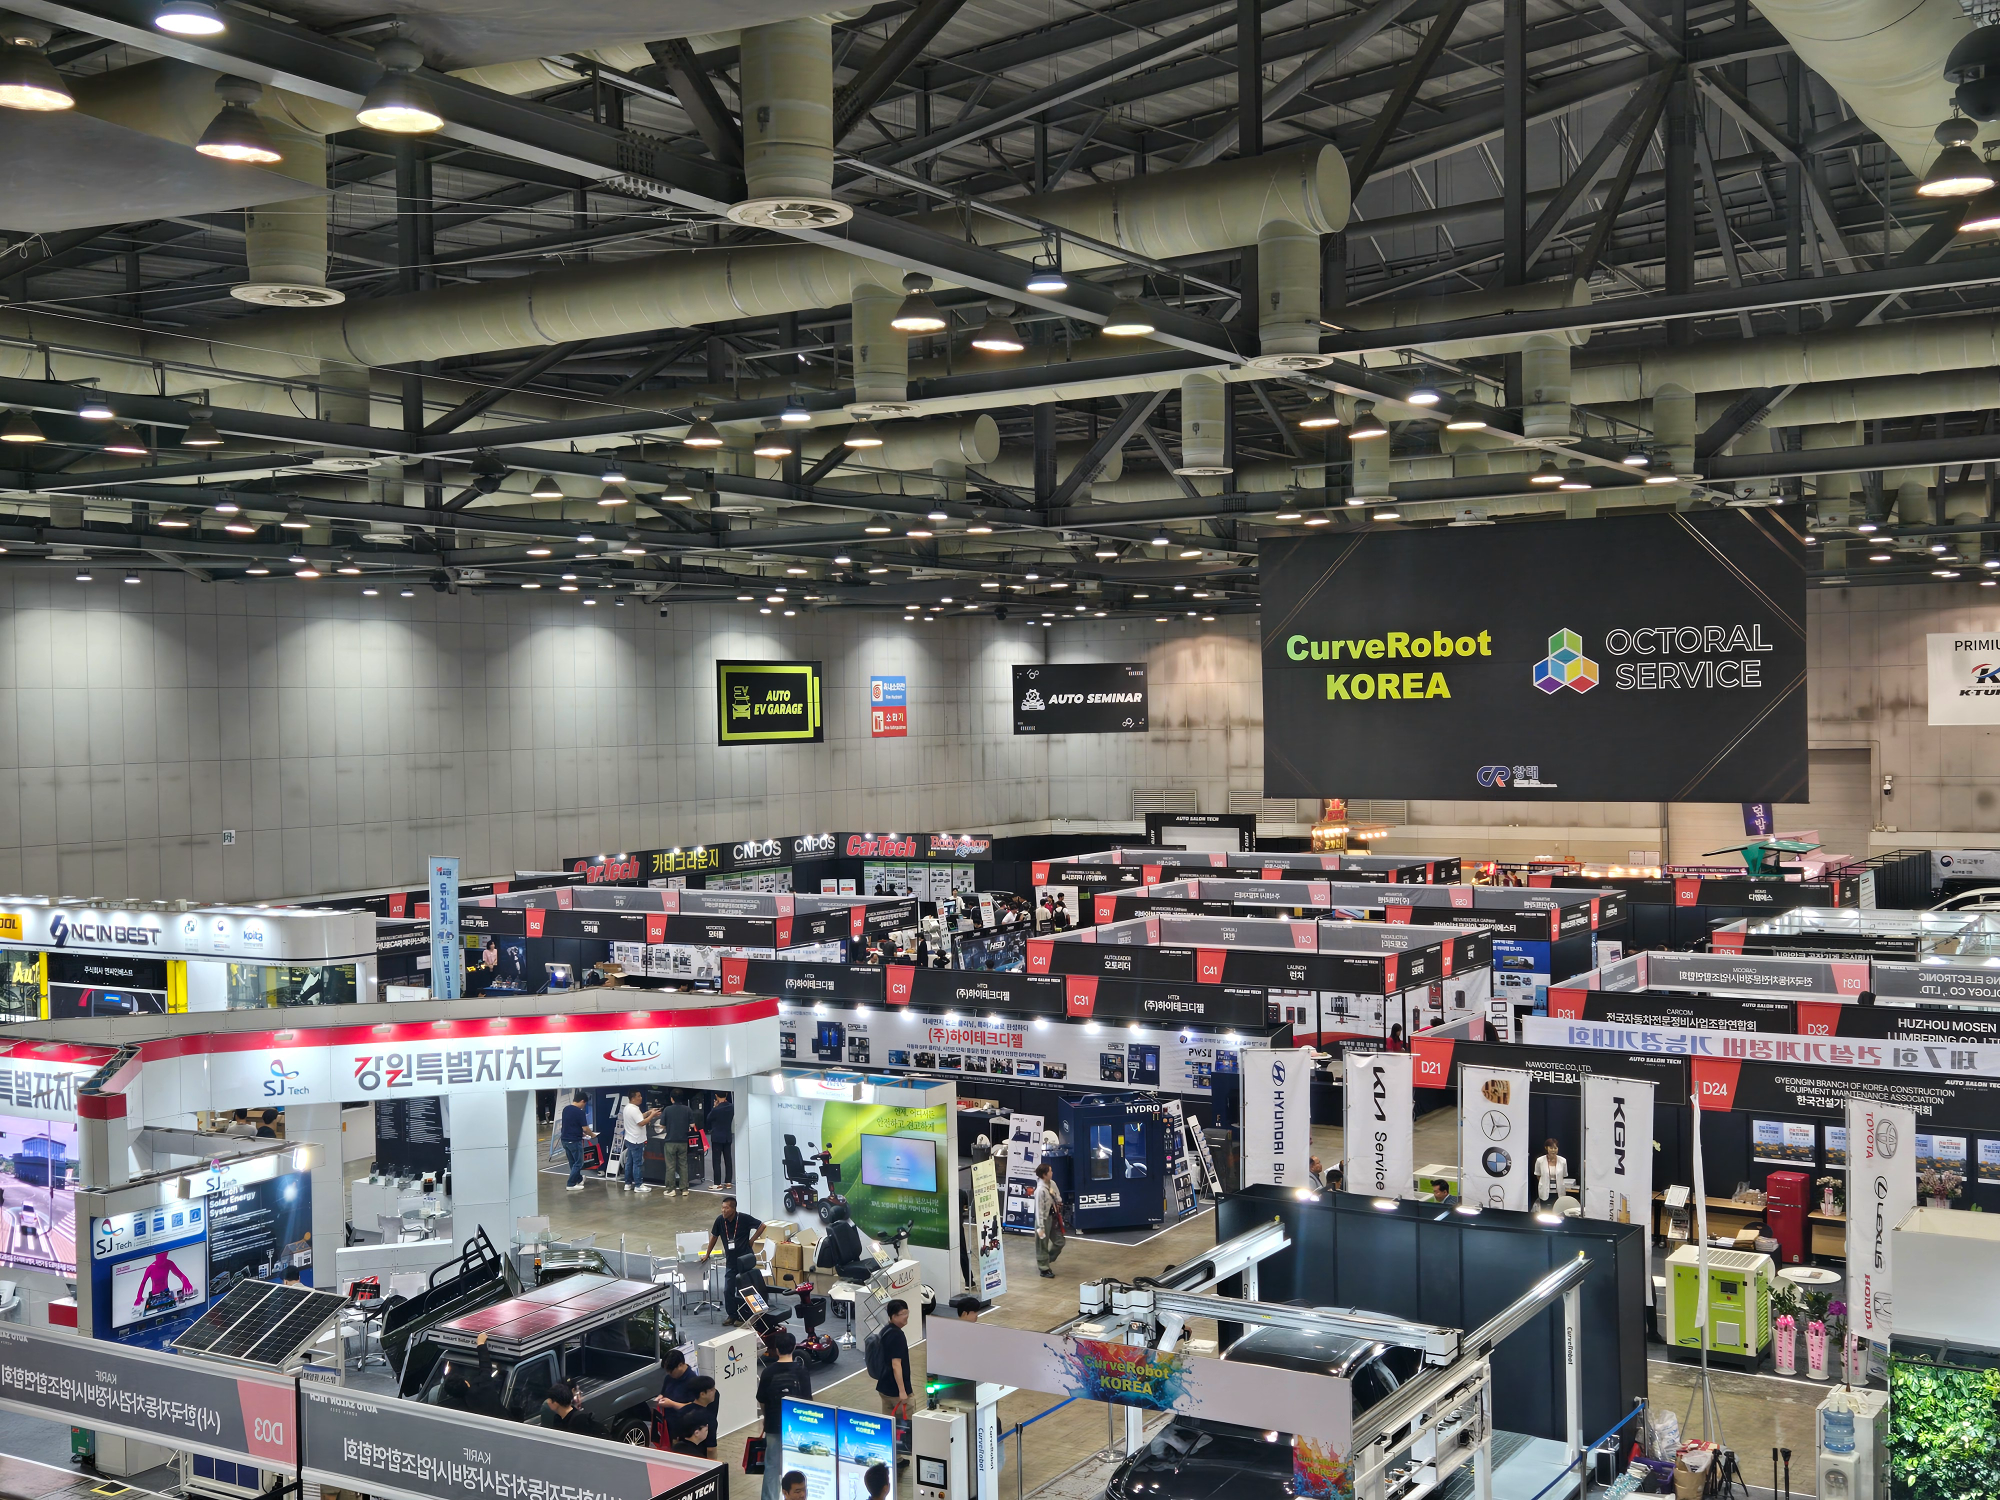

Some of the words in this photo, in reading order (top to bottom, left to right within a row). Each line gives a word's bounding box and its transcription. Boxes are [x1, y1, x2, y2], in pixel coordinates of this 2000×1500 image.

[1286, 629, 1492, 661] CurveRobot
[1606, 623, 1773, 656] OCTORAL
[1615, 659, 1762, 690] SERVICE
[1326, 671, 1451, 700] KOREA
[766, 690, 791, 702] AUTO
[1048, 694, 1084, 705] AUTO
[1086, 692, 1142, 704] SEMINAR
[754, 704, 767, 715] EV
[767, 704, 803, 715] GARAGE
[733, 841, 782, 860] CNPOS
[794, 836, 835, 853] CNPOS
[652, 848, 719, 873] 카테크라운지
[115, 926, 162, 945] BEST
[651, 928, 662, 936] B43
[1032, 956, 1046, 966] C41
[1105, 961, 1131, 971] 오토리더
[1203, 965, 1218, 976] C41
[1289, 971, 1305, 981] 런치
[728, 974, 741, 985] C31
[892, 983, 906, 994] C31
[1074, 995, 1089, 1006] C31
[1557, 1008, 1576, 1019] D31
[1666, 1008, 1694, 1016] CARCOM
[1606, 1012, 1757, 1032] 전국자동차전문정비사업조합연합회
[1808, 1024, 1829, 1036] D32
[1898, 1018, 1950, 1031] HUZHOU
[1952, 1020, 1997, 1034] MOSEN
[928, 1027, 1023, 1048] (주)하이테크디젤
[621, 1041, 660, 1057] KAC
[354, 1046, 563, 1091] 강원특별자치도
[1421, 1061, 1441, 1075] D21
[264, 1080, 286, 1097] SJ
[288, 1086, 310, 1096] Tech
[1703, 1082, 1728, 1096] D24
[1775, 1076, 1815, 1087] GYEONGIN
[1816, 1078, 1849, 1089] BRANCH
[1850, 1081, 1861, 1090] OF
[1863, 1082, 1889, 1093] KOREA
[1890, 1084, 1955, 1097] CONSTRUCTION
[1945, 1079, 1964, 1087] AUTO
[1965, 1080, 1988, 1088] SALON
[1373, 1067, 1386, 1122] KIA
[1785, 1085, 1830, 1096] EQUIPMENT
[1890, 1092, 1944, 1105] ASSOCIATION
[1126, 1104, 1160, 1114] HYDRO
[1274, 1091, 1285, 1155] HYUNDAI
[1613, 1096, 1626, 1176] KGM
[1866, 1112, 1874, 1159] TOYOTA
[1374, 1131, 1387, 1191] Service
[206, 1176, 220, 1193] SJ
[209, 1198, 229, 1209] Solar
[229, 1191, 256, 1204] Energy
[209, 1204, 238, 1218] System
[1875, 1202, 1884, 1270] LEXUS
[96, 1237, 113, 1255] SJ
[115, 1239, 133, 1250] Tech
[1864, 1274, 1873, 1330] HONDA
[724, 1363, 735, 1380] SJ
[736, 1364, 749, 1375] Tech
[1084, 1354, 1169, 1380] CurveRobot
[1100, 1376, 1152, 1395] KOREA
[793, 1408, 824, 1419] CurveRobot
[799, 1415, 818, 1424] KOREA
[849, 1418, 880, 1430] CurveRobot
[855, 1426, 875, 1436] KOREA
[1307, 1466, 1338, 1480] KOREA
[695, 1481, 715, 1500] TECH
